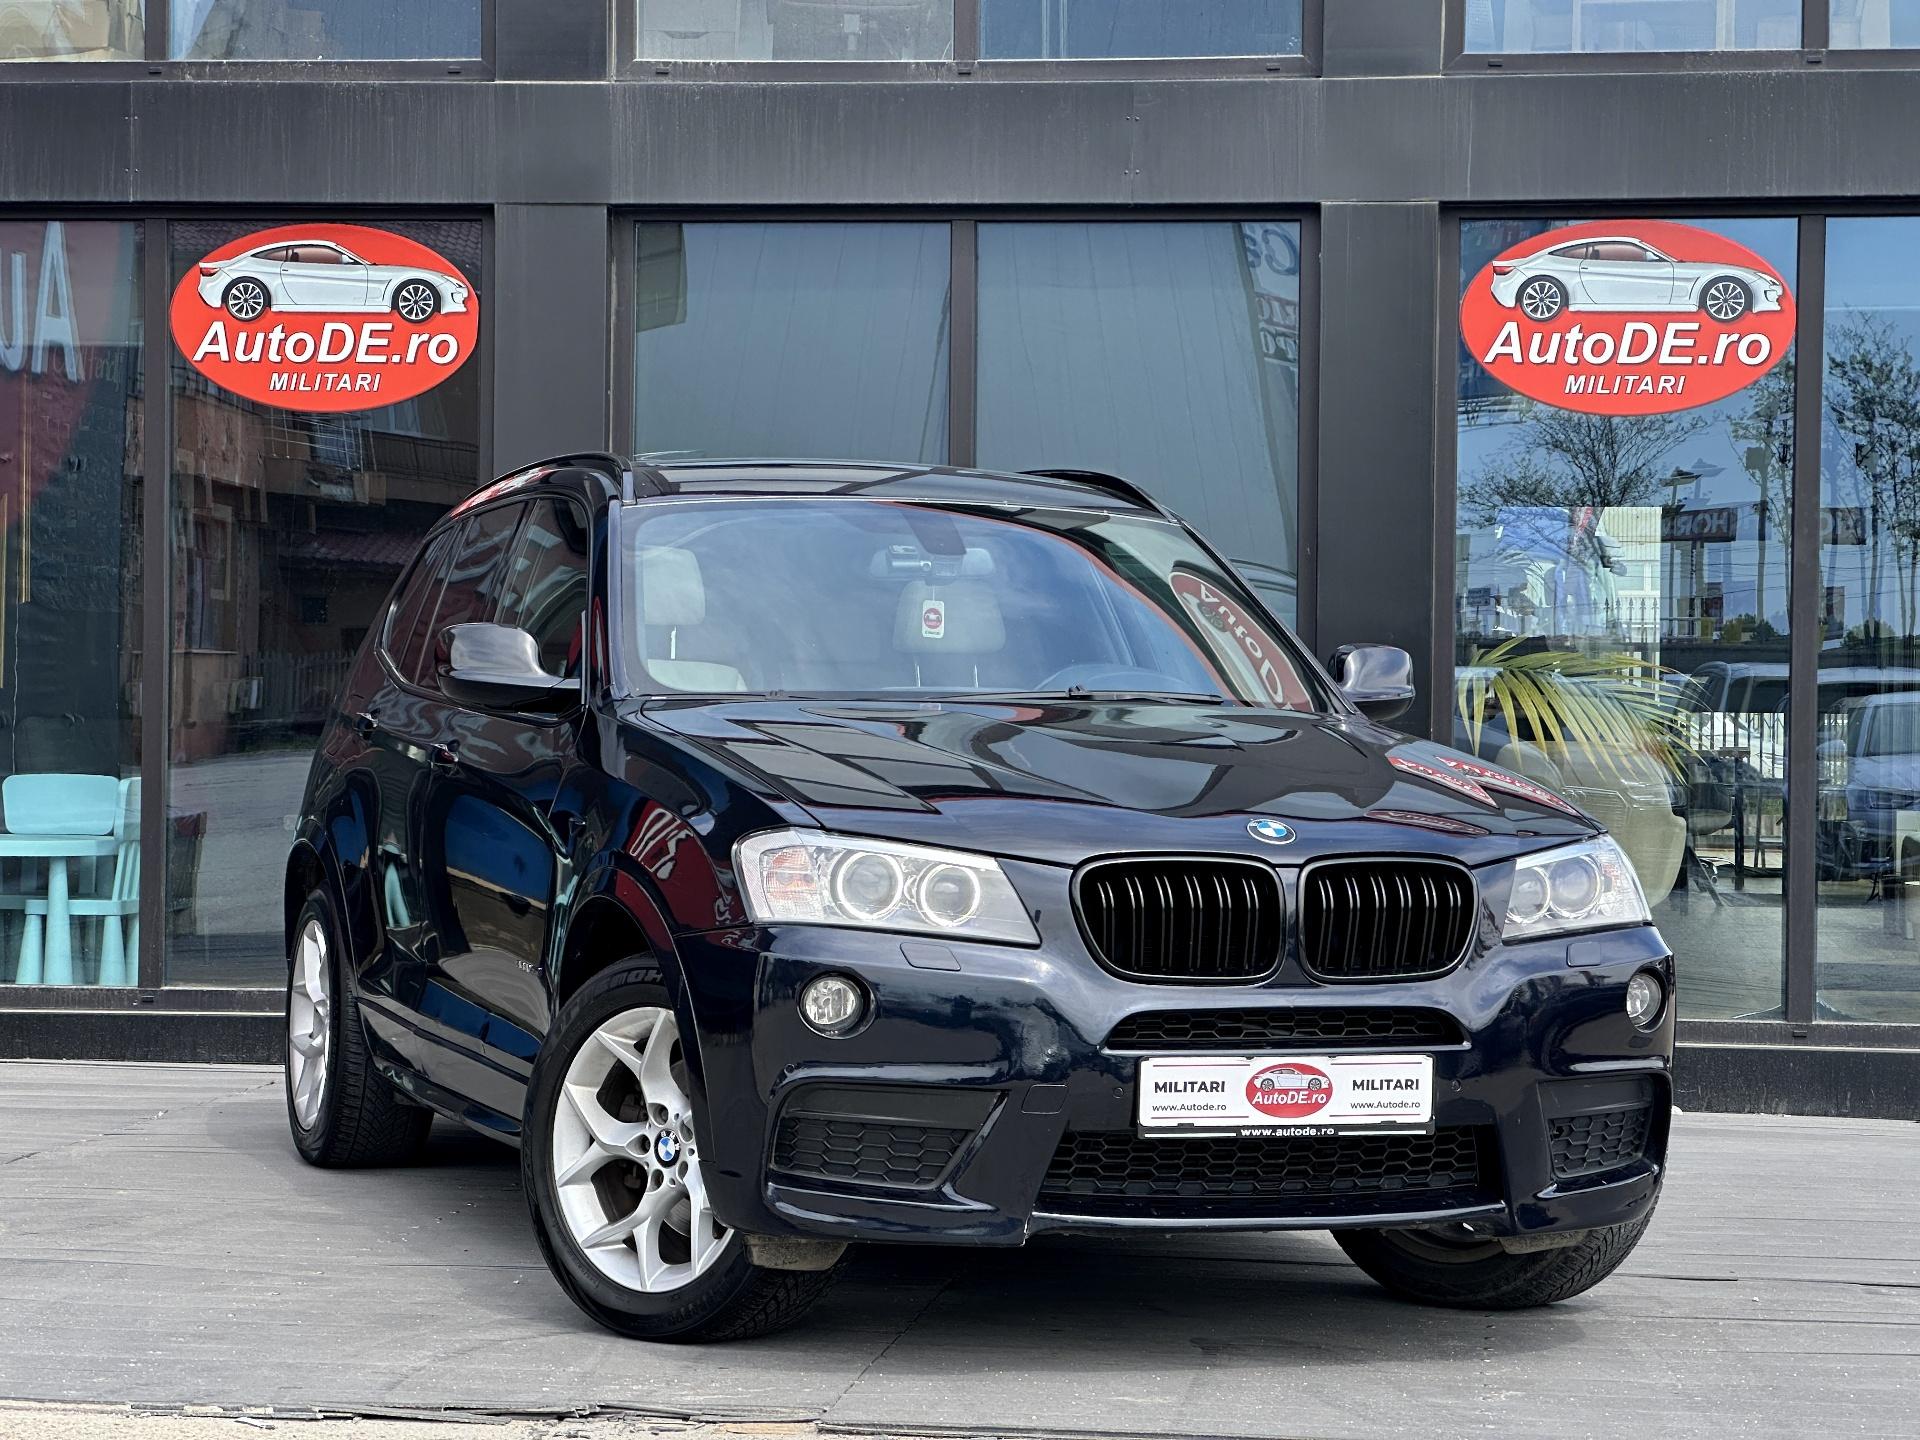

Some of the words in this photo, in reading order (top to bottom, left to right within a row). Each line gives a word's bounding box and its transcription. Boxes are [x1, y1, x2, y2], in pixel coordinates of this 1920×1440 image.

[193, 321, 459, 365] AutoDE.ro
[1483, 321, 1772, 367] AutoDE.ro
[269, 372, 382, 392] MILITARI
[1564, 375, 1687, 395] MILITARI
[1154, 1081, 1226, 1094] MILITARI
[1352, 1078, 1420, 1091] MILITARI
[1251, 1090, 1327, 1105] AutoDE.ro
[1151, 1102, 1227, 1112] www.Autode.ro
[1350, 1100, 1421, 1110] www.Autode.ro
[1240, 1126, 1335, 1137] www.autode.ro
